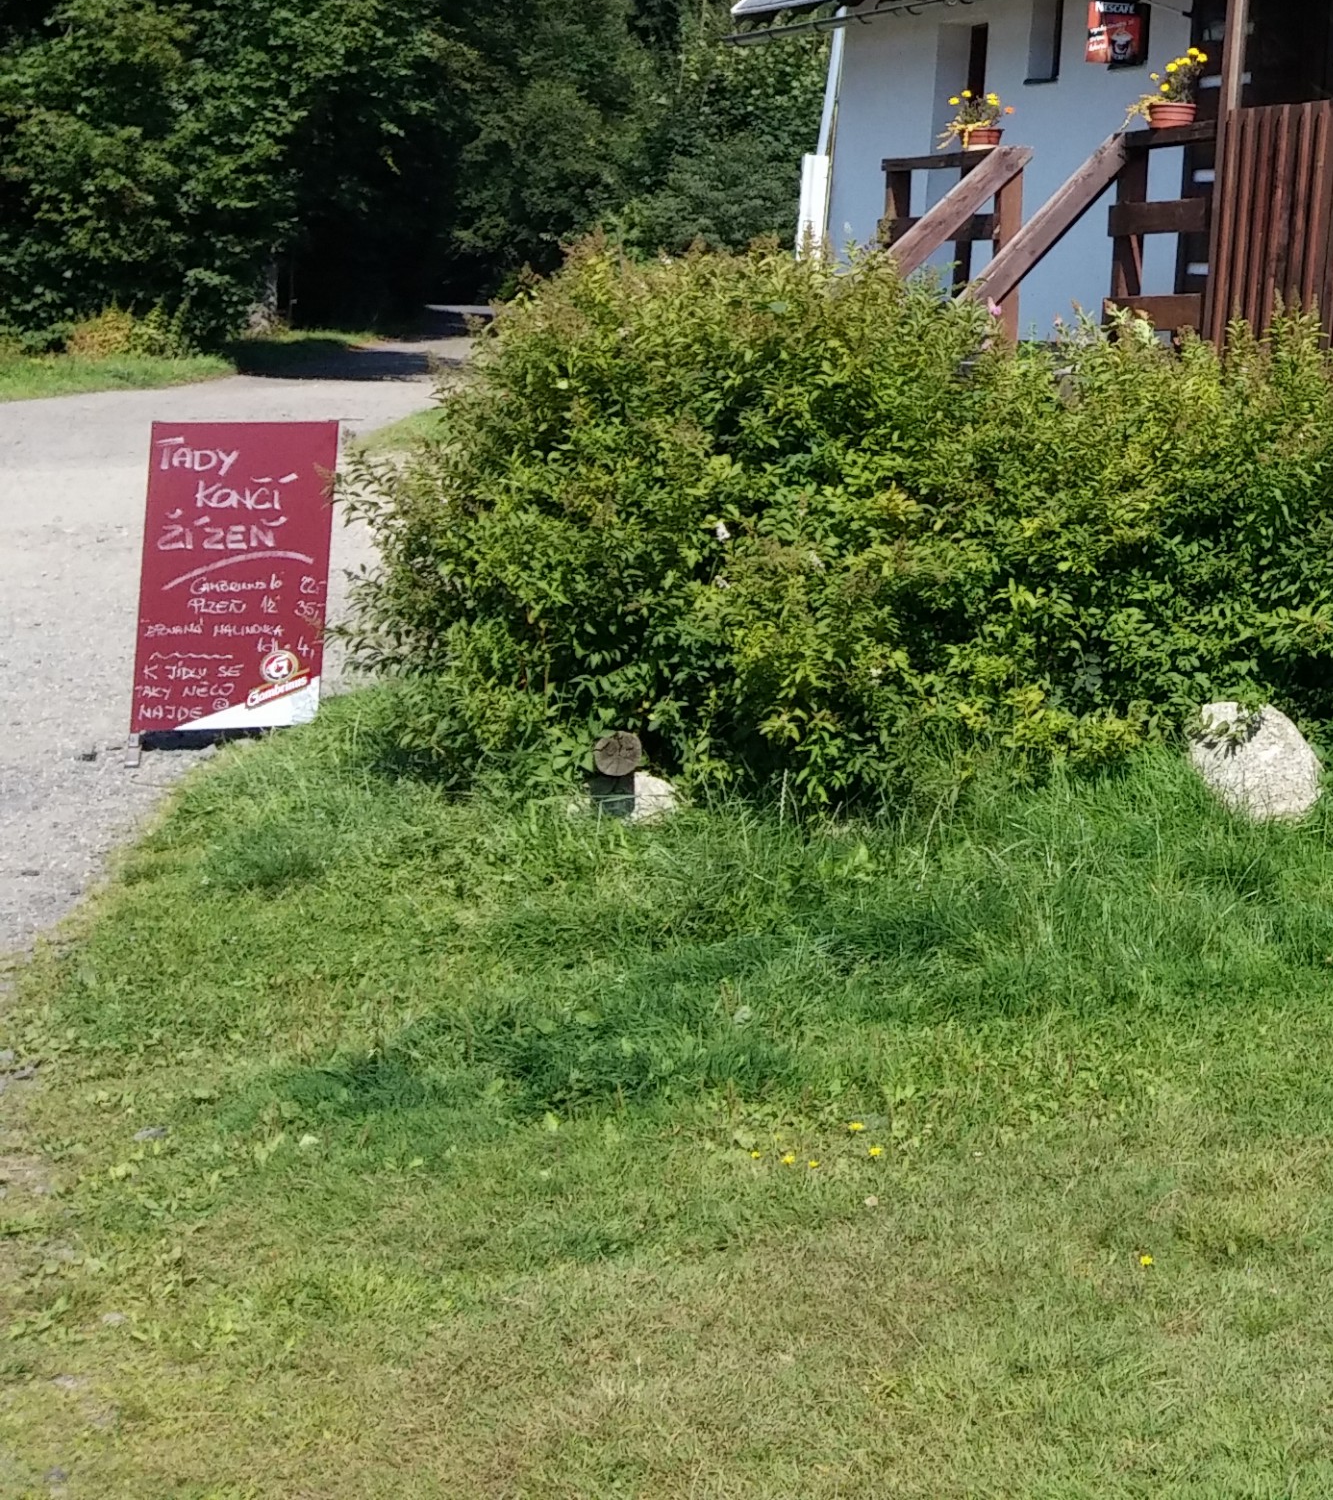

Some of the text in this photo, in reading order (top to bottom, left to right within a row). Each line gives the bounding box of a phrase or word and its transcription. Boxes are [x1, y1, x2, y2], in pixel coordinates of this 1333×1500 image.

[156, 437, 240, 477] TADY
[195, 472, 299, 510] KONČÍ
[157, 508, 289, 550] ŽÍZEŇ
[187, 597, 247, 615] PLZEŇ
[143, 664, 159, 680] K
[217, 664, 245, 678] SE
[135, 686, 171, 700] TAKY
[246, 674, 308, 707] Gambrinus
[137, 704, 203, 721] NAJDE
